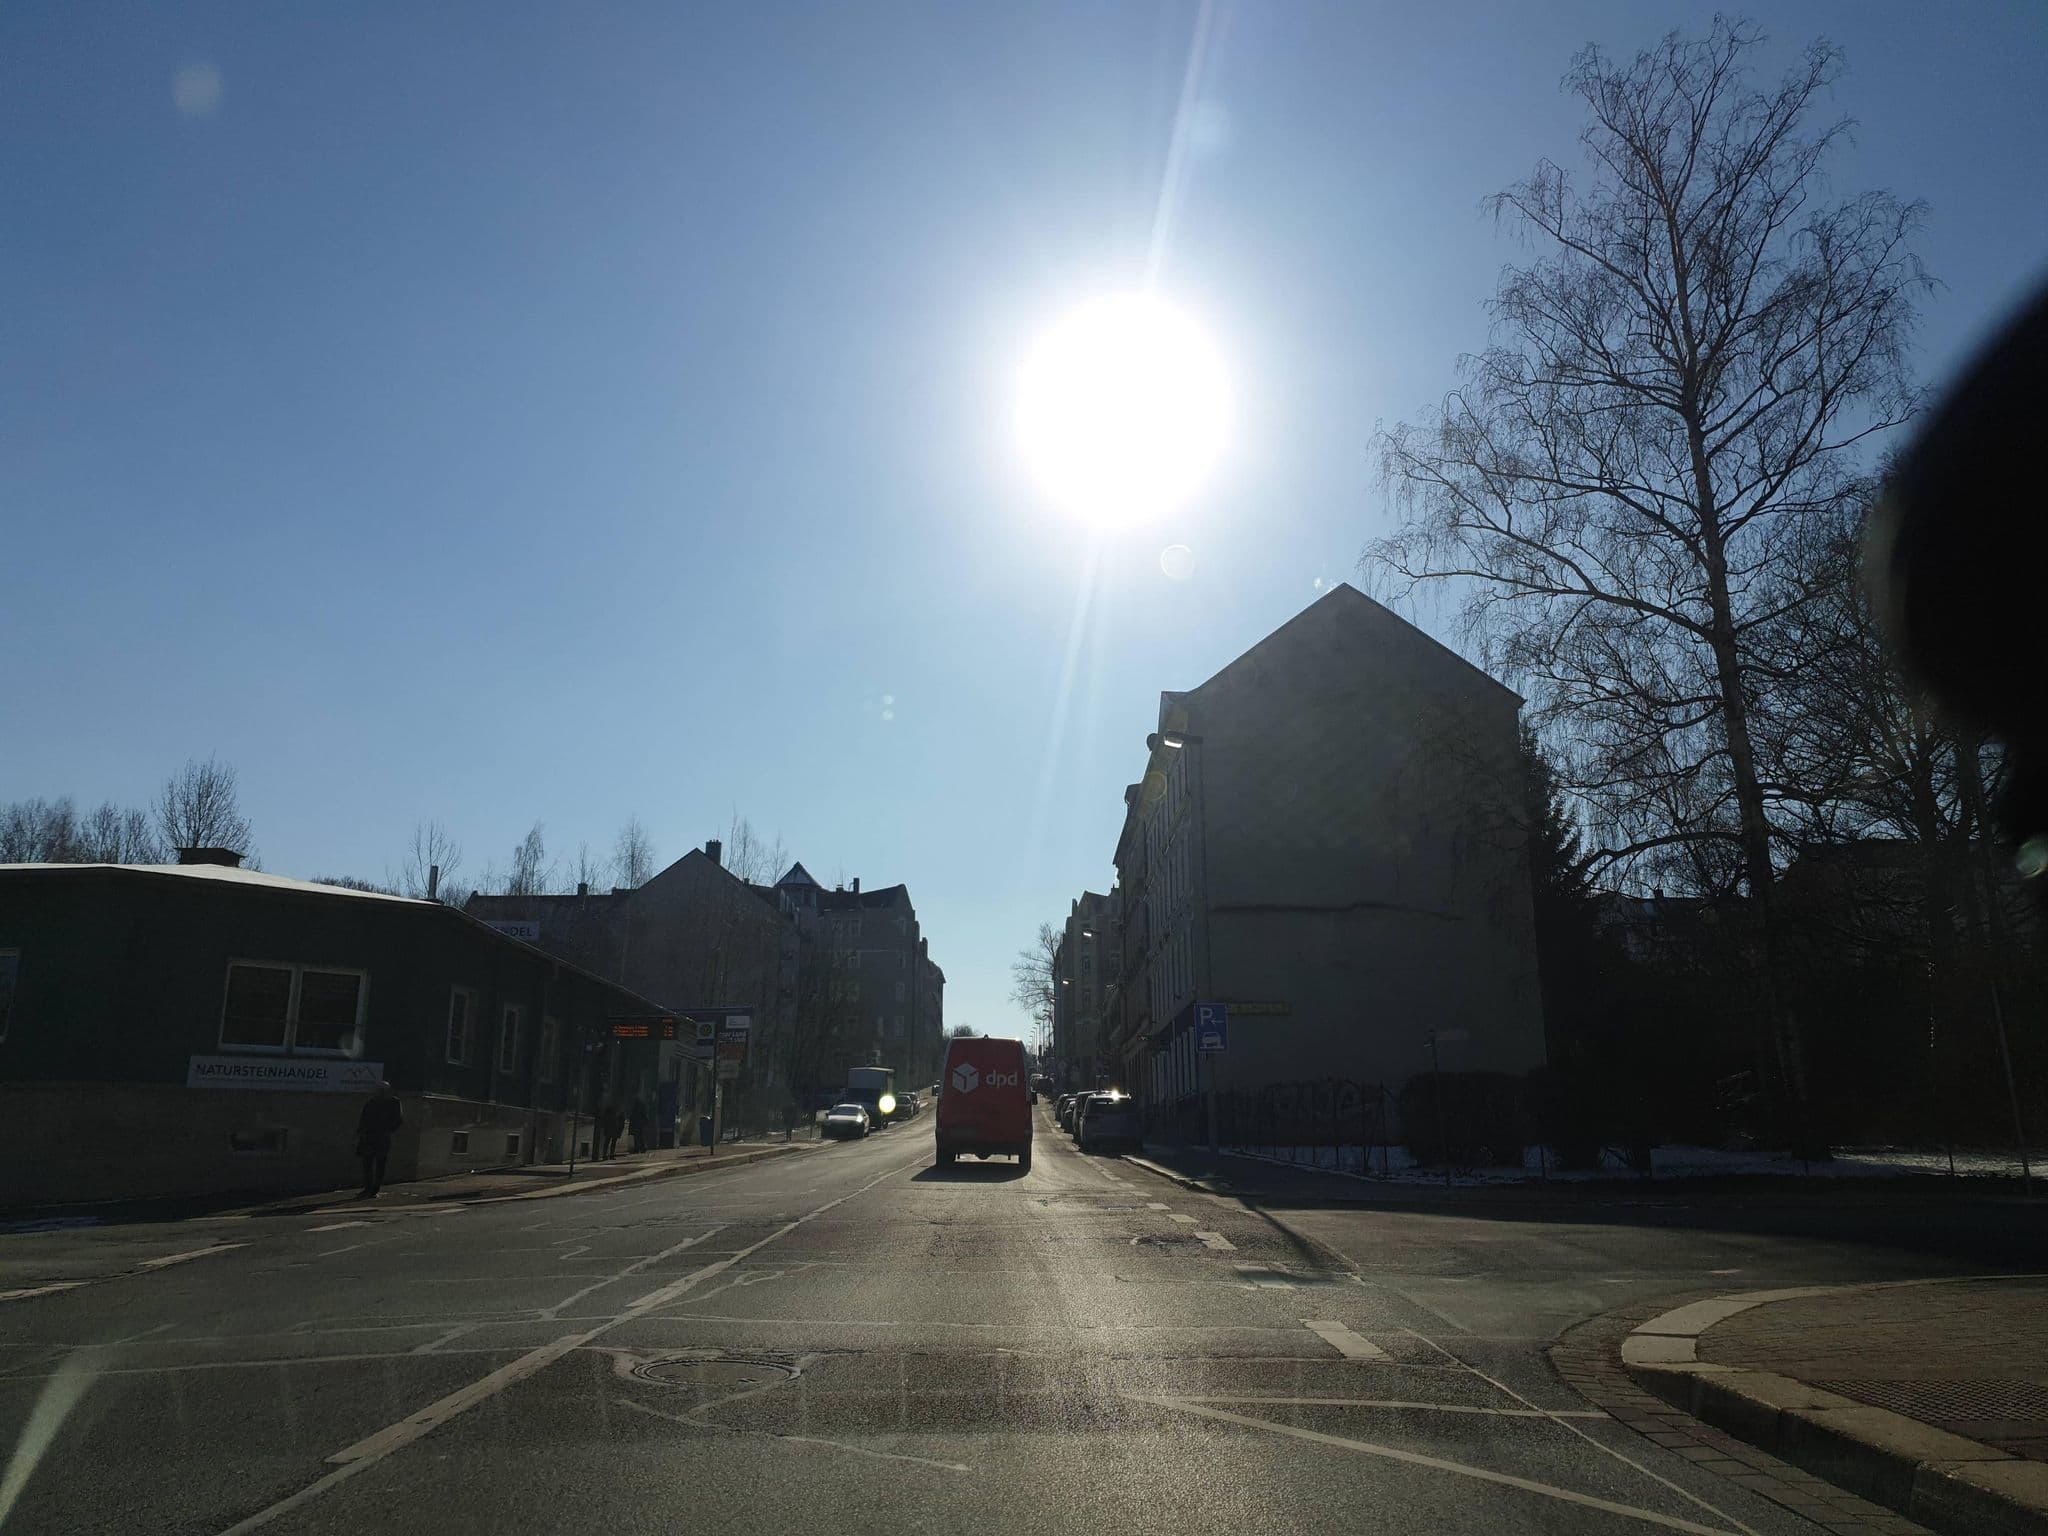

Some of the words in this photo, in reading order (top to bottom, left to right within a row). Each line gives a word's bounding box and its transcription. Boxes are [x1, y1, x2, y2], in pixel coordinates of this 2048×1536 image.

[1200, 1007, 1213, 1026] P
[195, 1063, 329, 1080] NATURSTEINHANDEL
[986, 1069, 1018, 1089] dpd
